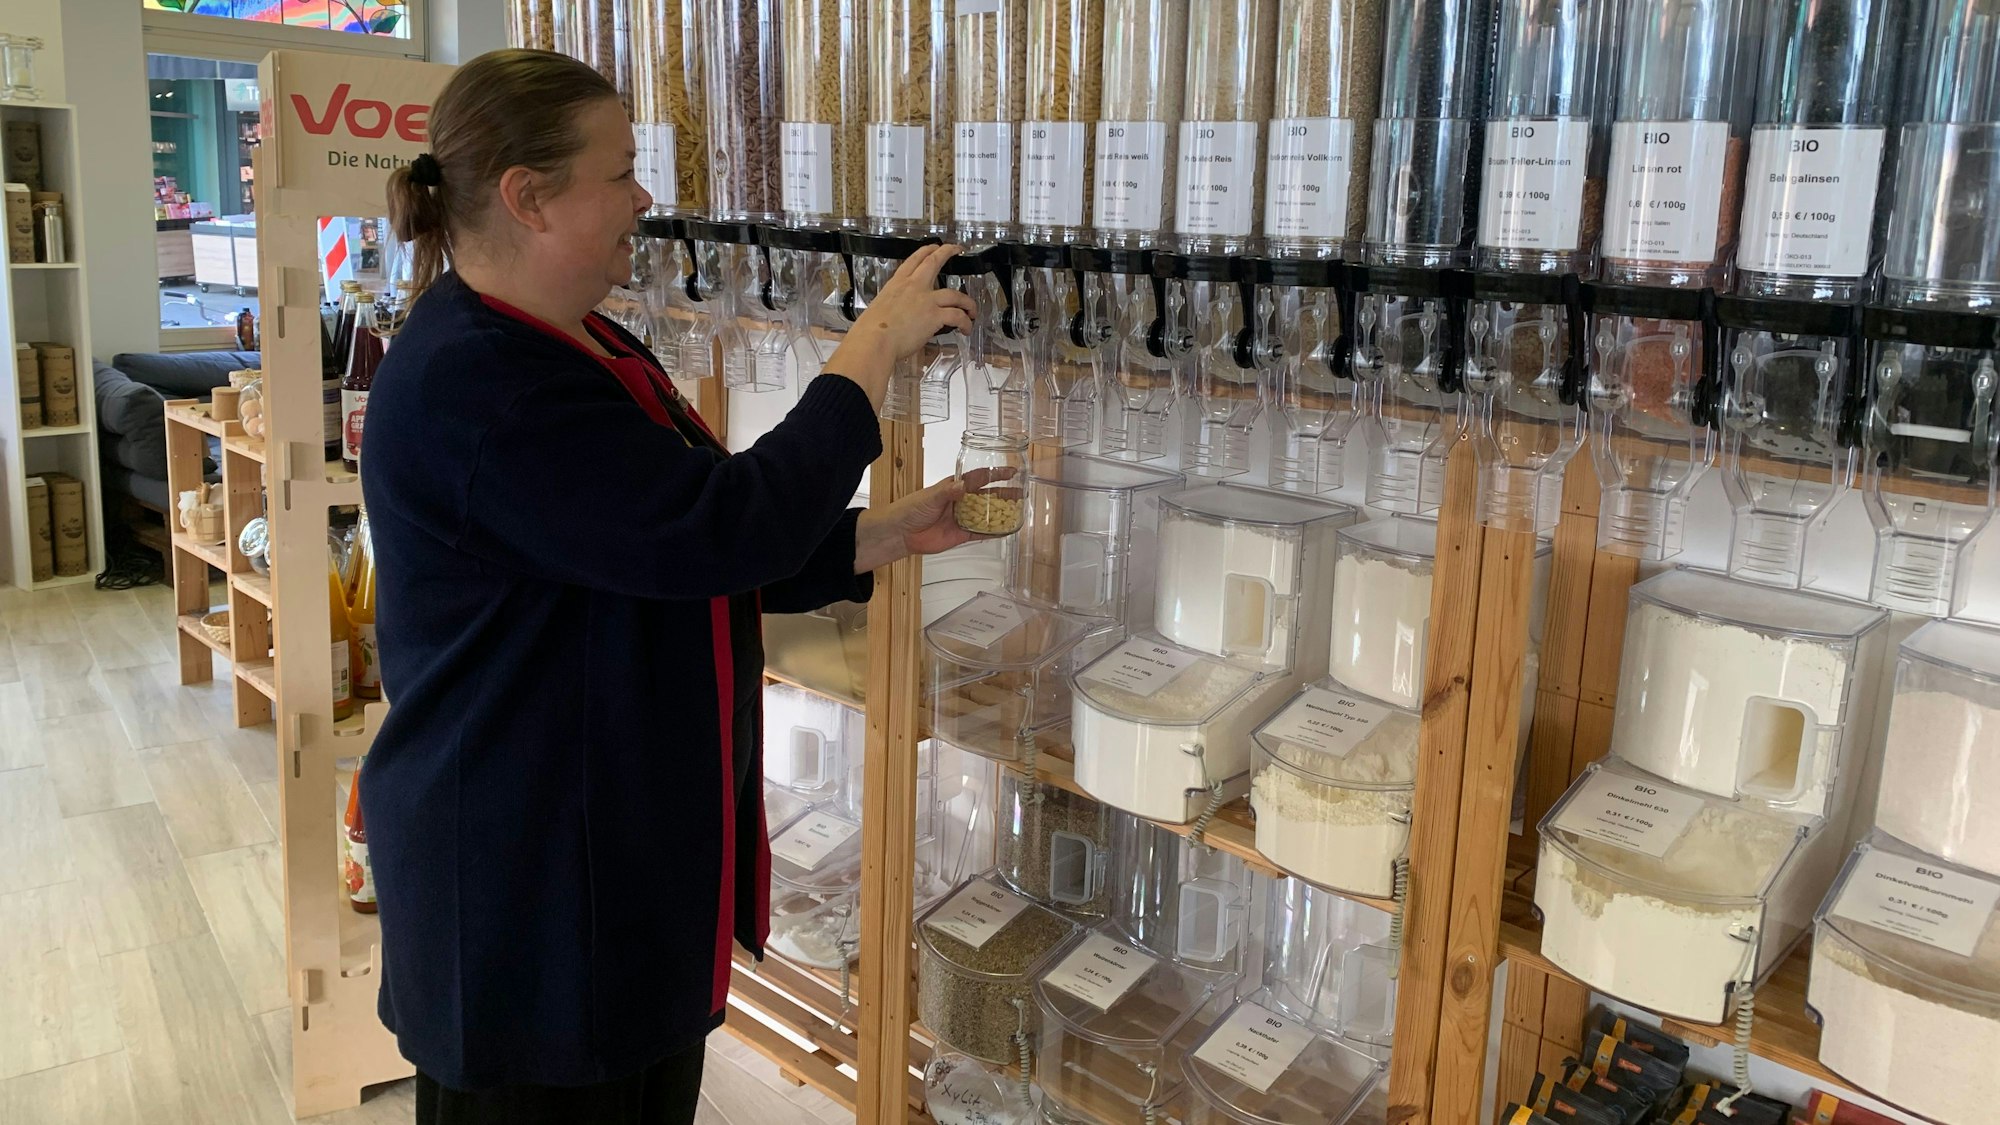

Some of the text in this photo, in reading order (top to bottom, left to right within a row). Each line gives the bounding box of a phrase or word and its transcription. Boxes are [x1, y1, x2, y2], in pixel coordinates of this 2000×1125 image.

[1032, 129, 1046, 139] BIO
[1108, 128, 1124, 138] BIO
[1196, 128, 1214, 139] BIO
[1288, 126, 1307, 136] BIO
[1512, 126, 1534, 138] BIO
[1644, 132, 1670, 144] BIO
[1790, 140, 1819, 152] BIO
[328, 150, 358, 168] Die
[1307, 154, 1342, 162] Vollkorn
[1632, 164, 1663, 173] Linsen
[1210, 184, 1228, 193] 100g
[1302, 184, 1320, 193] 100g
[1529, 192, 1550, 200] 100g
[1663, 201, 1686, 210] 100g
[1794, 212, 1801, 220] €
[1810, 212, 1836, 222] 100g
[1338, 699, 1355, 708] BIO
[1306, 703, 1343, 719] Weizenmehl
[1330, 725, 1343, 733] 100g
[1635, 785, 1656, 795] BIO
[1607, 792, 1668, 813] Dinkelmehl 630
[1636, 818, 1653, 828] 100g
[1916, 867, 1943, 880] BIO
[1876, 872, 1974, 904] Dinkelvollkornmehl
[1888, 896, 1906, 905] 0,31
[1926, 908, 1948, 919] 100g
[1113, 946, 1128, 955] BIO
[1266, 1017, 1283, 1028] BIO
[1248, 1027, 1279, 1044] Nackthafer
[1256, 1051, 1269, 1060] 100g
